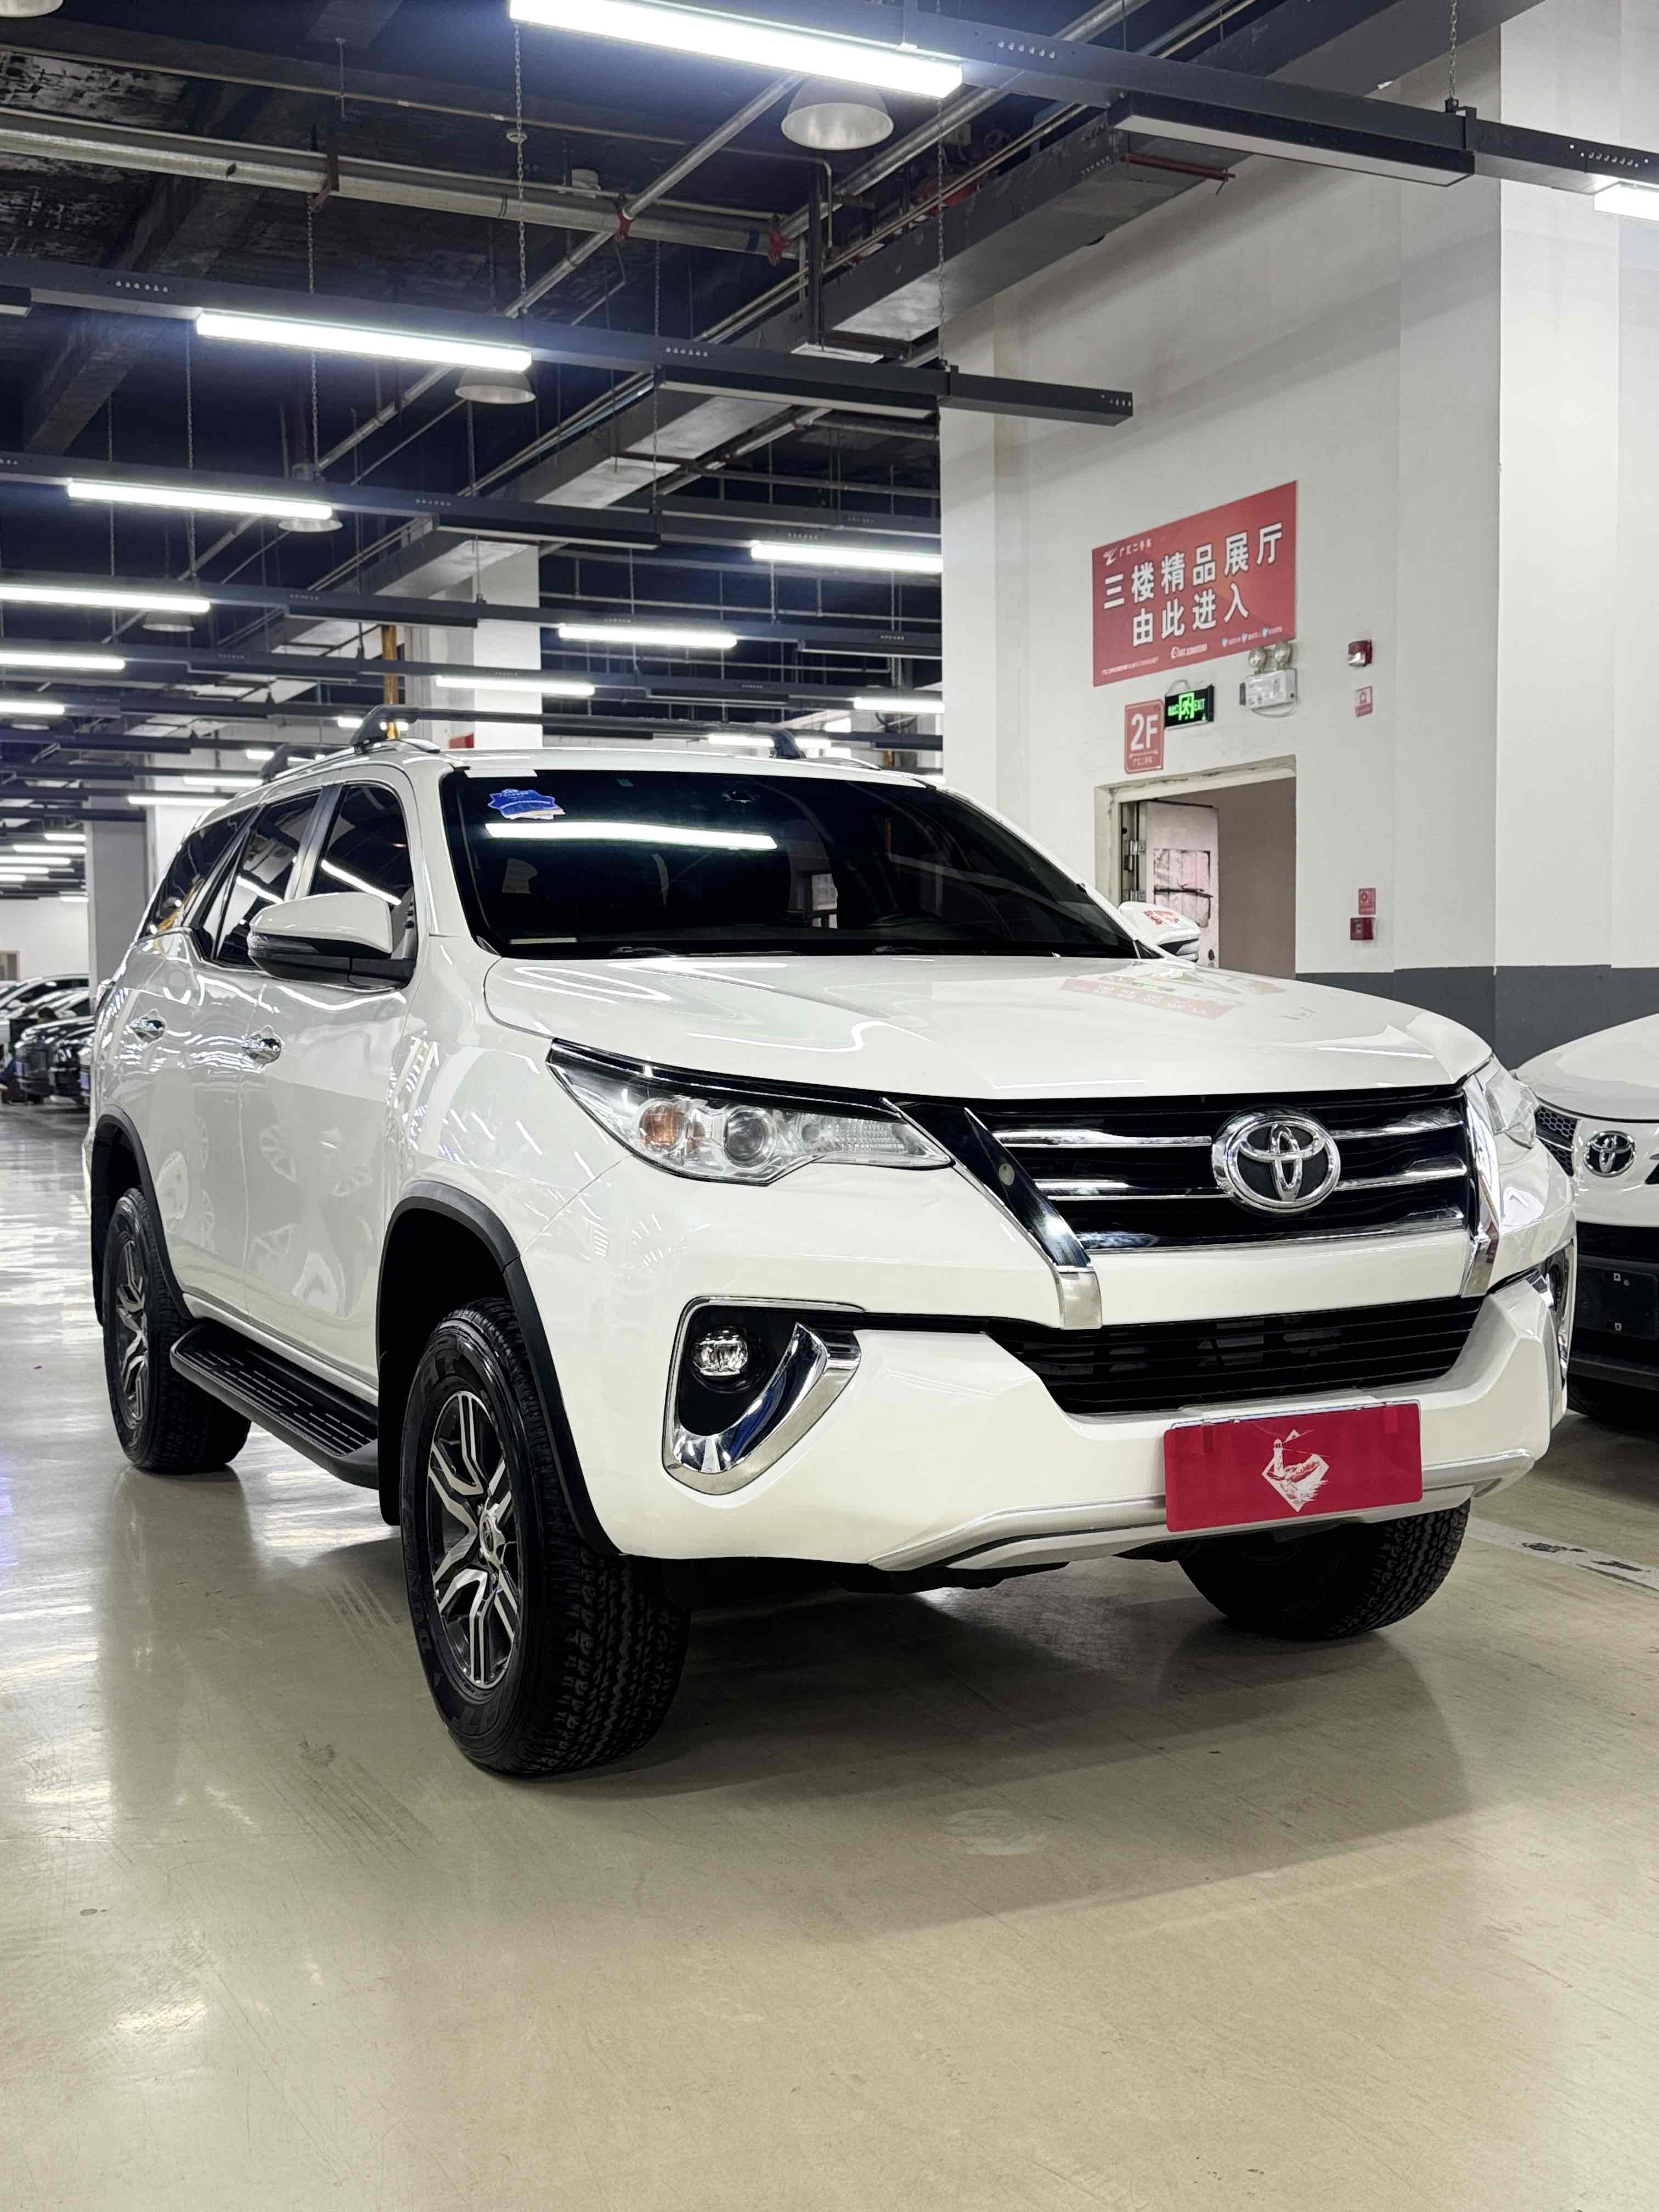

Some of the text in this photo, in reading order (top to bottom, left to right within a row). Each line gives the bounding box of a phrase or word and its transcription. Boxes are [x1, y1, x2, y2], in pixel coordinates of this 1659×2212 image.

[1103, 522, 1283, 610] 三楼精品展厅
[1132, 582, 1249, 647] 由此进入
[1131, 713, 1159, 751] 2F
